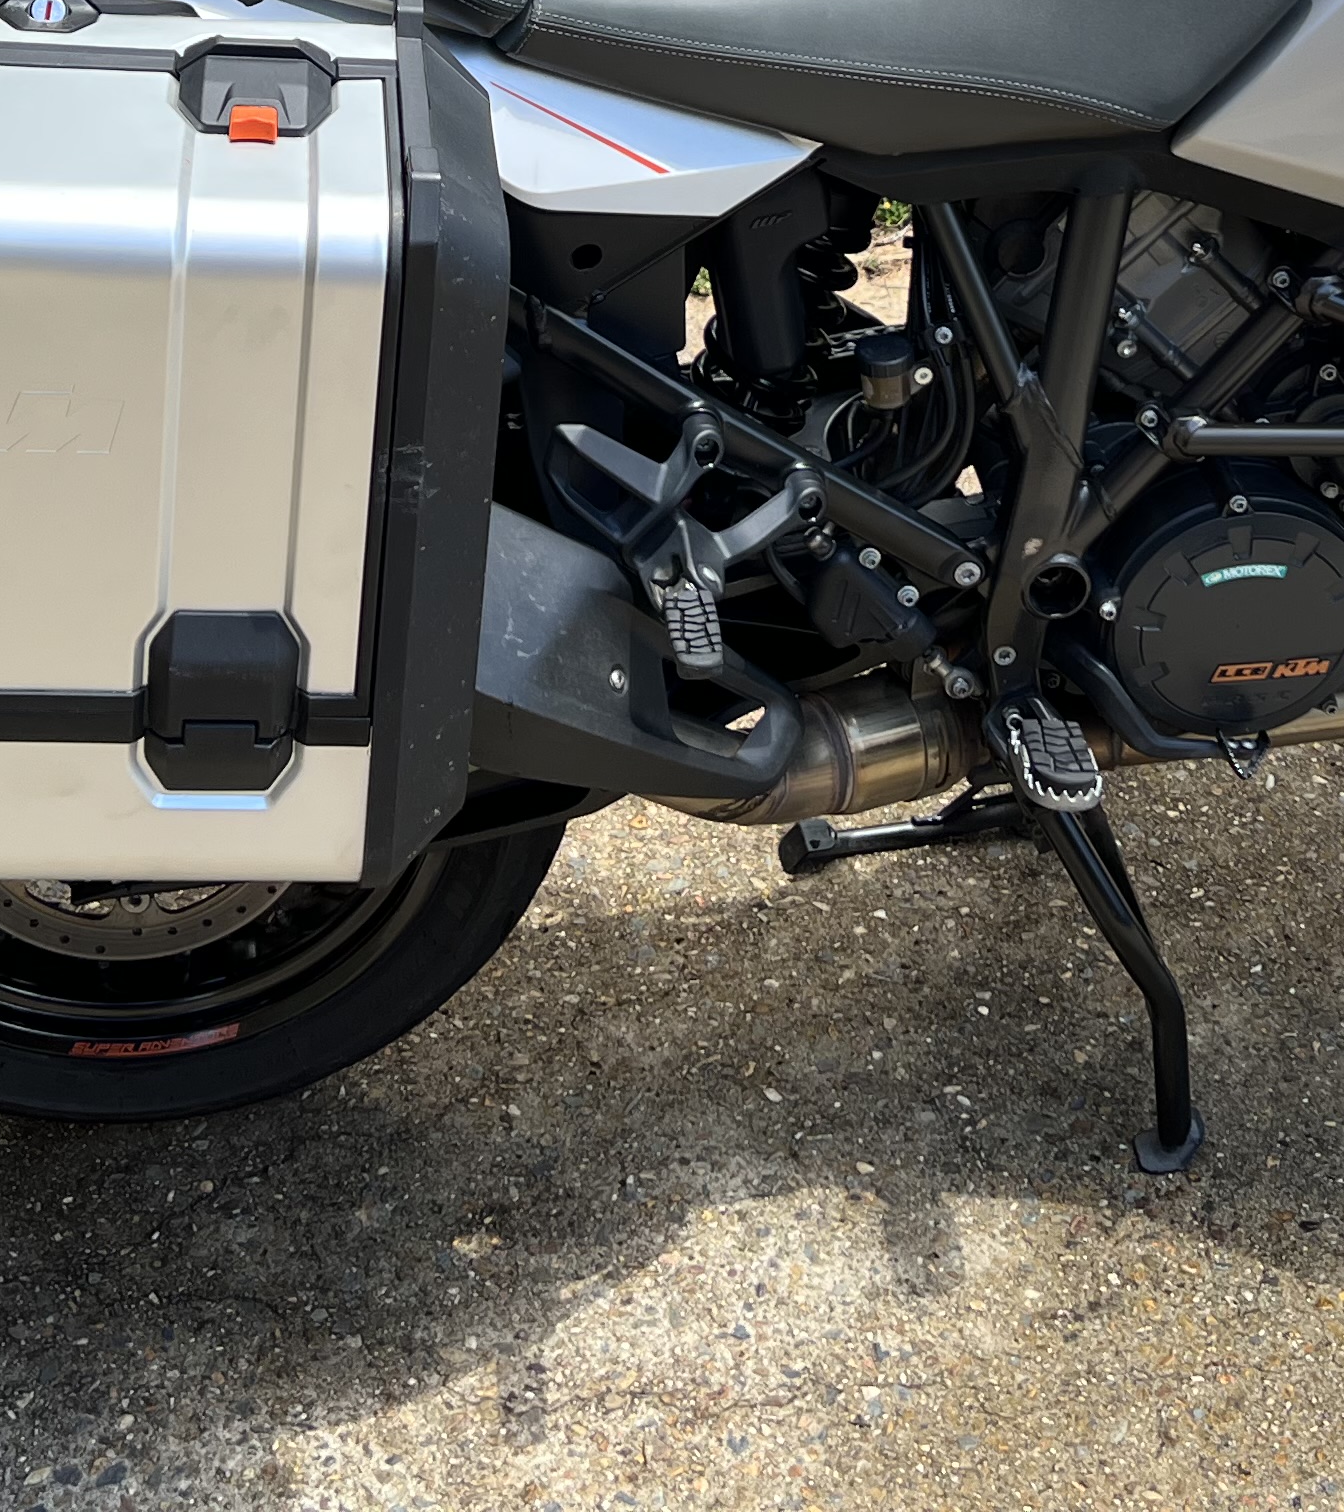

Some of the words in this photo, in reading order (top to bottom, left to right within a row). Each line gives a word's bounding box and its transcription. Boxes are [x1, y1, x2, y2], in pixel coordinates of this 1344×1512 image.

[1223, 564, 1282, 580] MOTOREX
[1273, 657, 1330, 678] KTM
[70, 1041, 134, 1057] SUPER
[138, 1022, 240, 1053] ADVENRE
